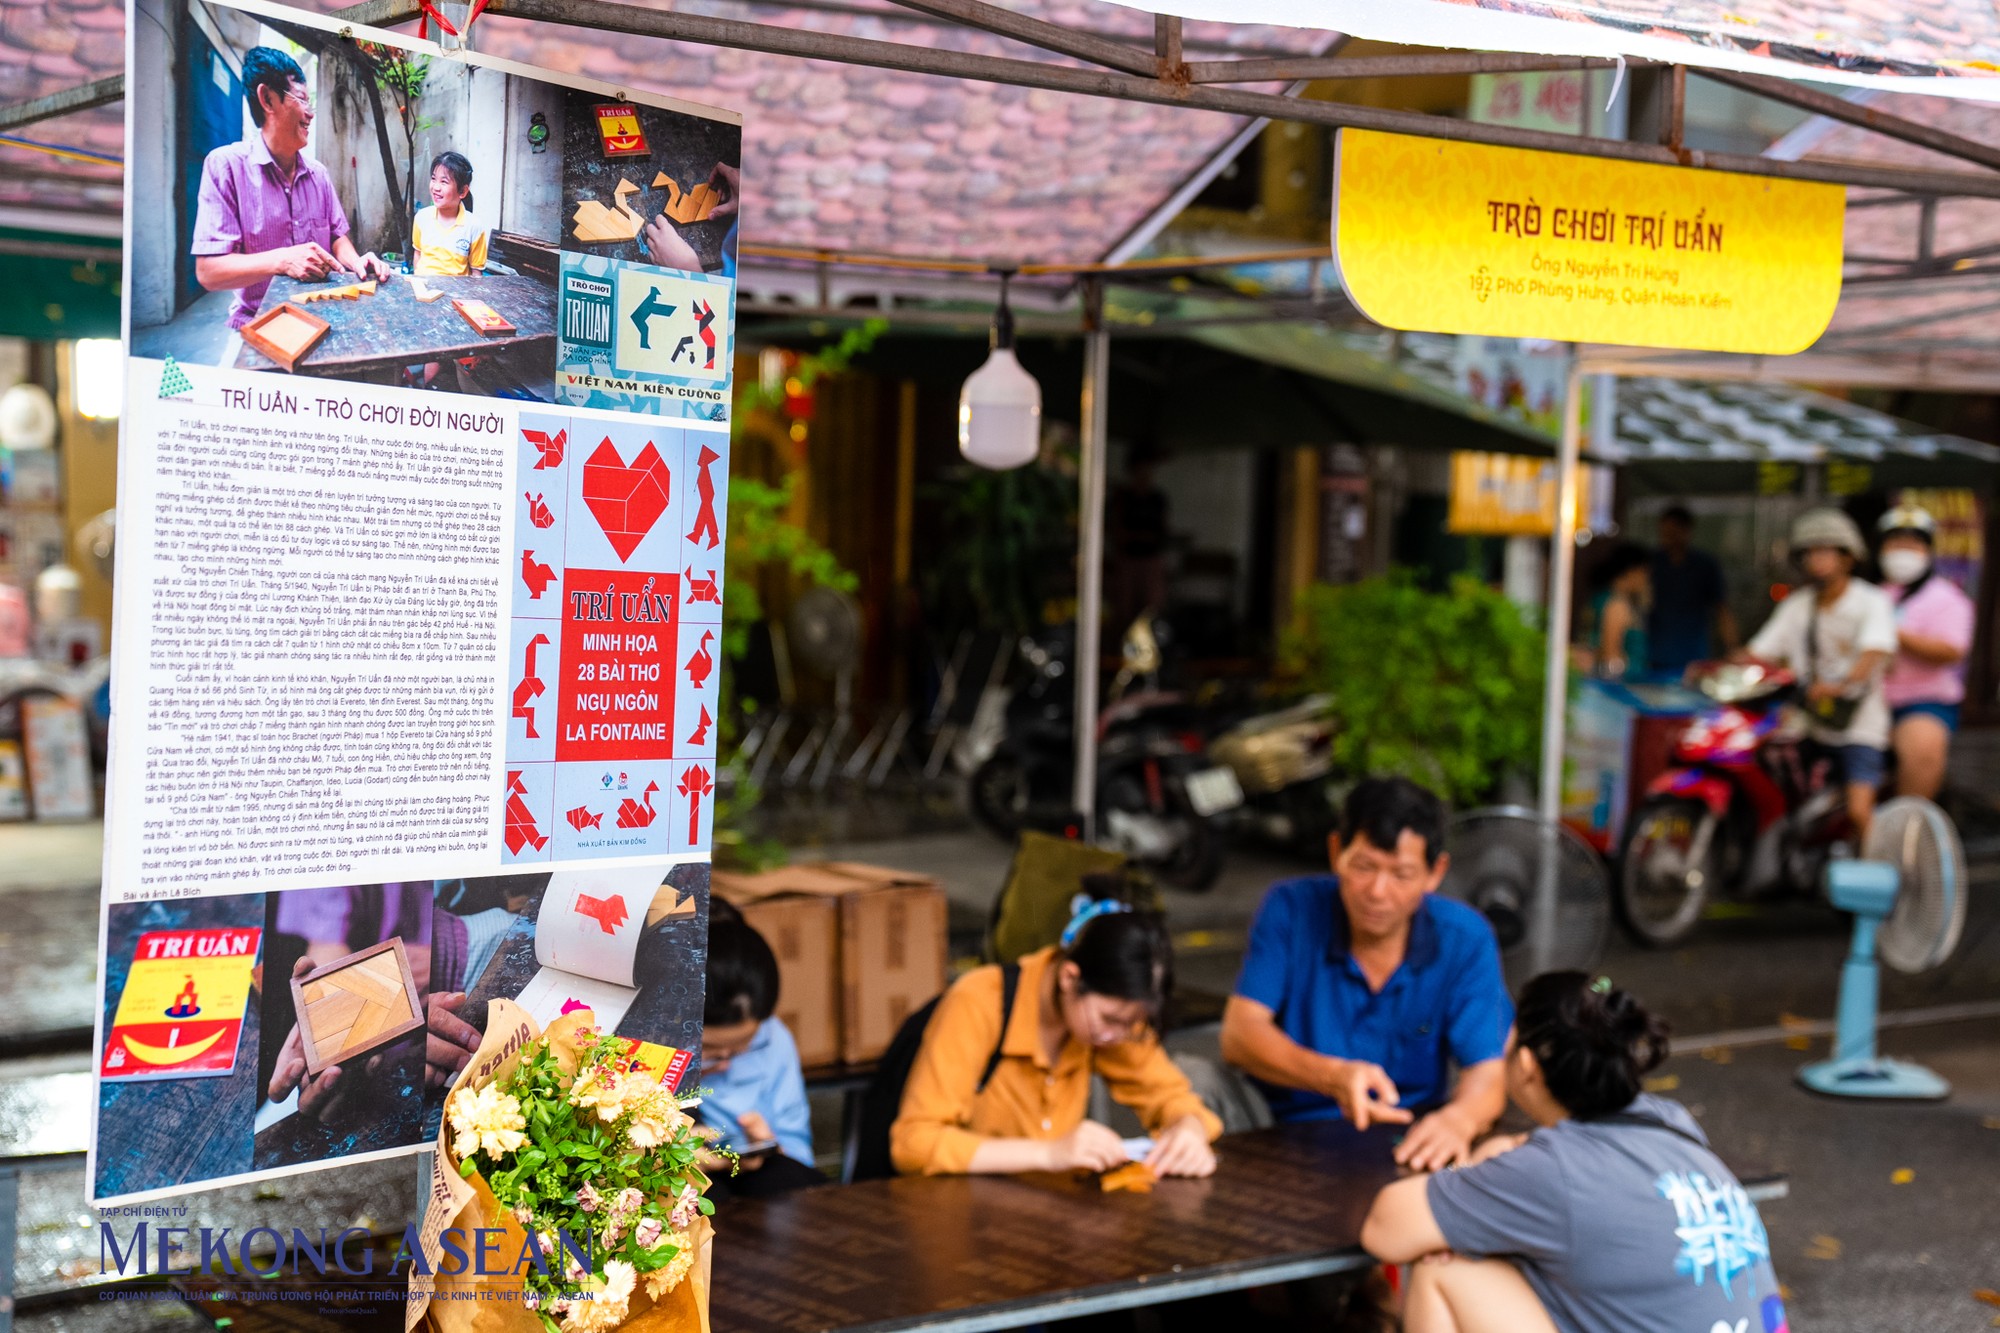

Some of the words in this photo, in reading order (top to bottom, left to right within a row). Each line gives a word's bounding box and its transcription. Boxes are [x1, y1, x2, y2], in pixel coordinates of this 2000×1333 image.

[1488, 197, 1541, 238] TRÒ
[1553, 208, 1616, 243] CHƠI
[1625, 211, 1667, 250] TRÍ
[1674, 207, 1723, 252] UẨN
[1531, 253, 1560, 275] Ông
[1566, 258, 1619, 280] Nguyễn
[571, 281, 587, 289] TRÒ
[589, 284, 609, 293] CHƠI
[1529, 281, 1573, 301] Phùng
[567, 375, 600, 387] VIỆT
[605, 380, 637, 391] NAM
[644, 383, 674, 395] KIÊN
[678, 388, 721, 400] CƯỜNG
[221, 387, 252, 410] TRÍ
[259, 390, 297, 414] UẨN
[315, 397, 353, 420] TRÒ
[359, 403, 404, 425] CHƠI
[410, 406, 441, 428] ĐỜI
[447, 412, 504, 434] NGƯỜI
[571, 583, 614, 621] TRÍ
[621, 577, 672, 623] UẨN
[583, 634, 621, 651] MINH
[625, 634, 658, 656] HỌA
[578, 663, 595, 681] 28
[599, 658, 624, 681] BÀI
[629, 662, 660, 681] THƠ
[577, 693, 610, 715] NGỤ
[615, 690, 658, 711] NGÔN
[566, 724, 586, 741] LA
[591, 723, 666, 741] FONTAINE
[148, 934, 195, 959] TRÍ
